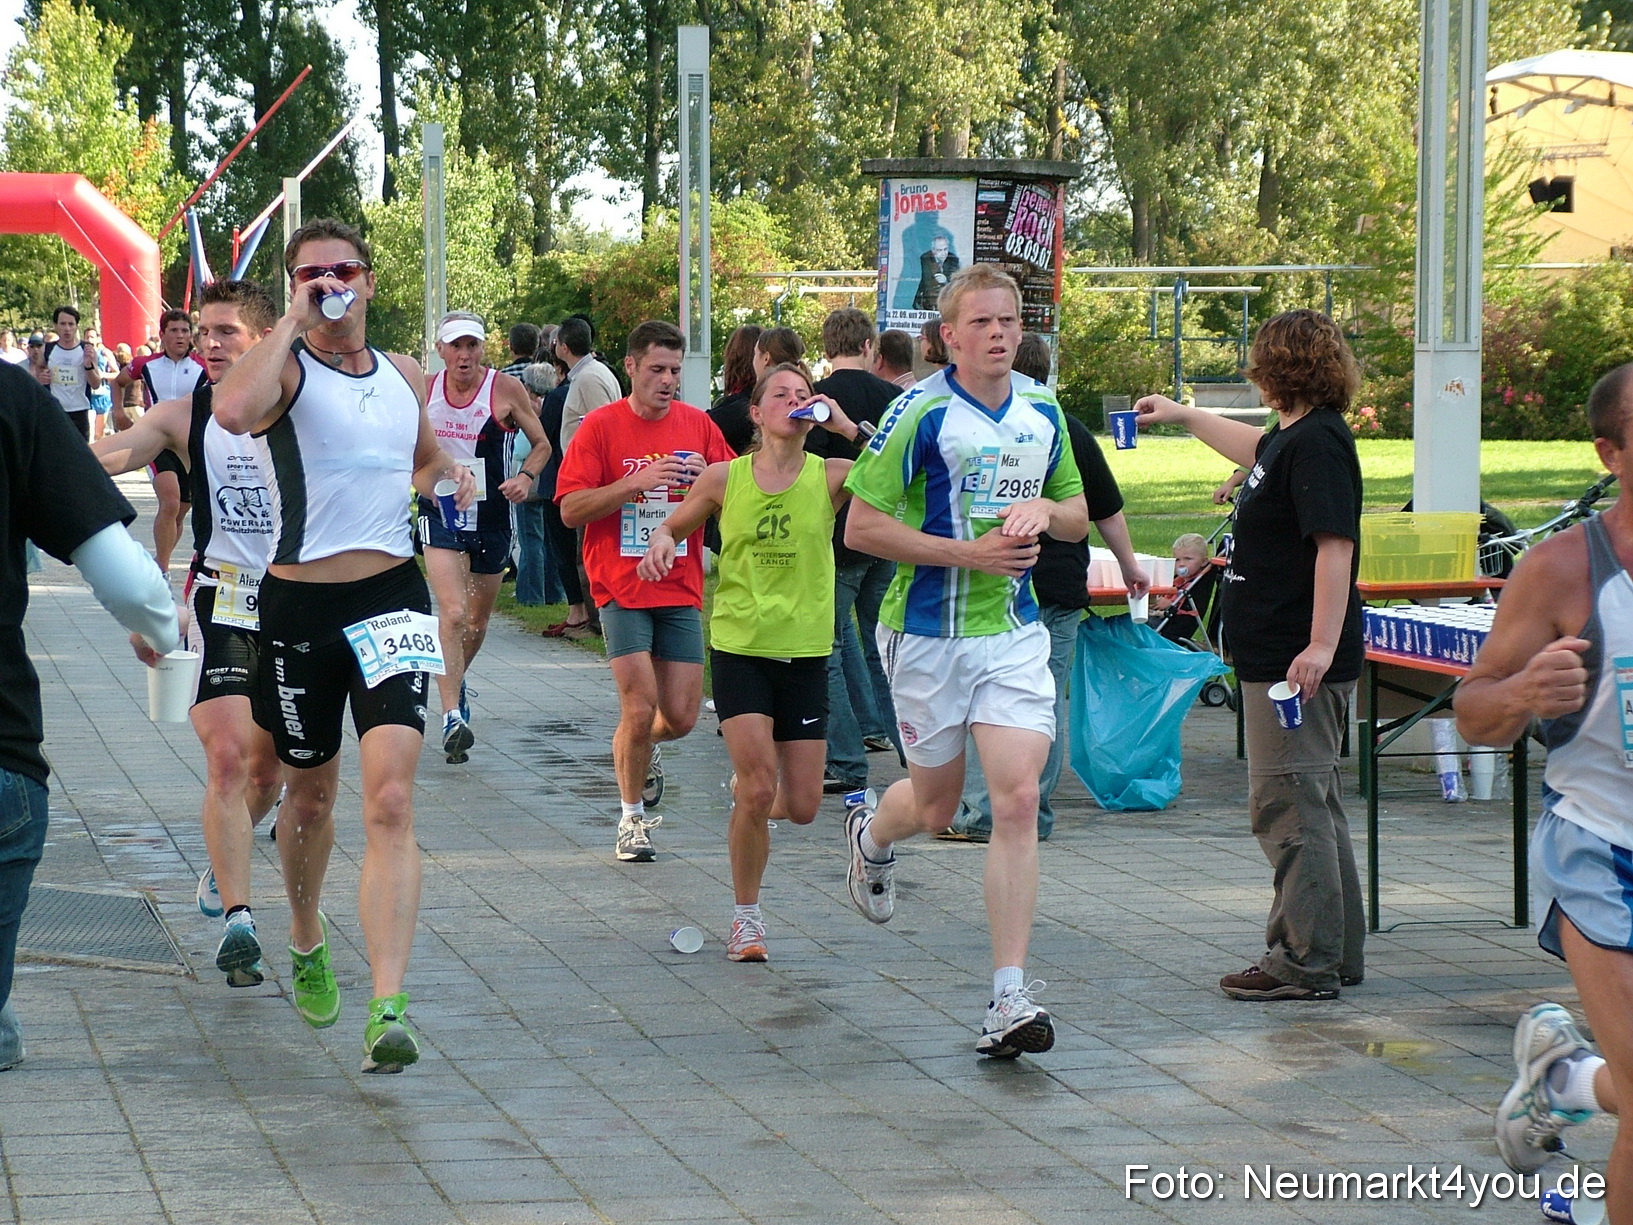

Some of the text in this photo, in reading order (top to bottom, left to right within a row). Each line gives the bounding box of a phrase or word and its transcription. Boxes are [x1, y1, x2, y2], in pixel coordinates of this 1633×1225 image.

[901, 184, 928, 195] Bruno
[1005, 232, 1052, 271] 08.09.07
[445, 421, 455, 429] TS
[869, 386, 925, 456] BOCK
[1001, 454, 1020, 467] Max
[981, 474, 987, 485] B
[996, 478, 1041, 499] 2985
[639, 508, 666, 519] Martin
[238, 573, 260, 587] Alex
[219, 586, 225, 595] A
[370, 613, 412, 631] Roland
[383, 633, 436, 655] 3468
[360, 647, 368, 658] A
